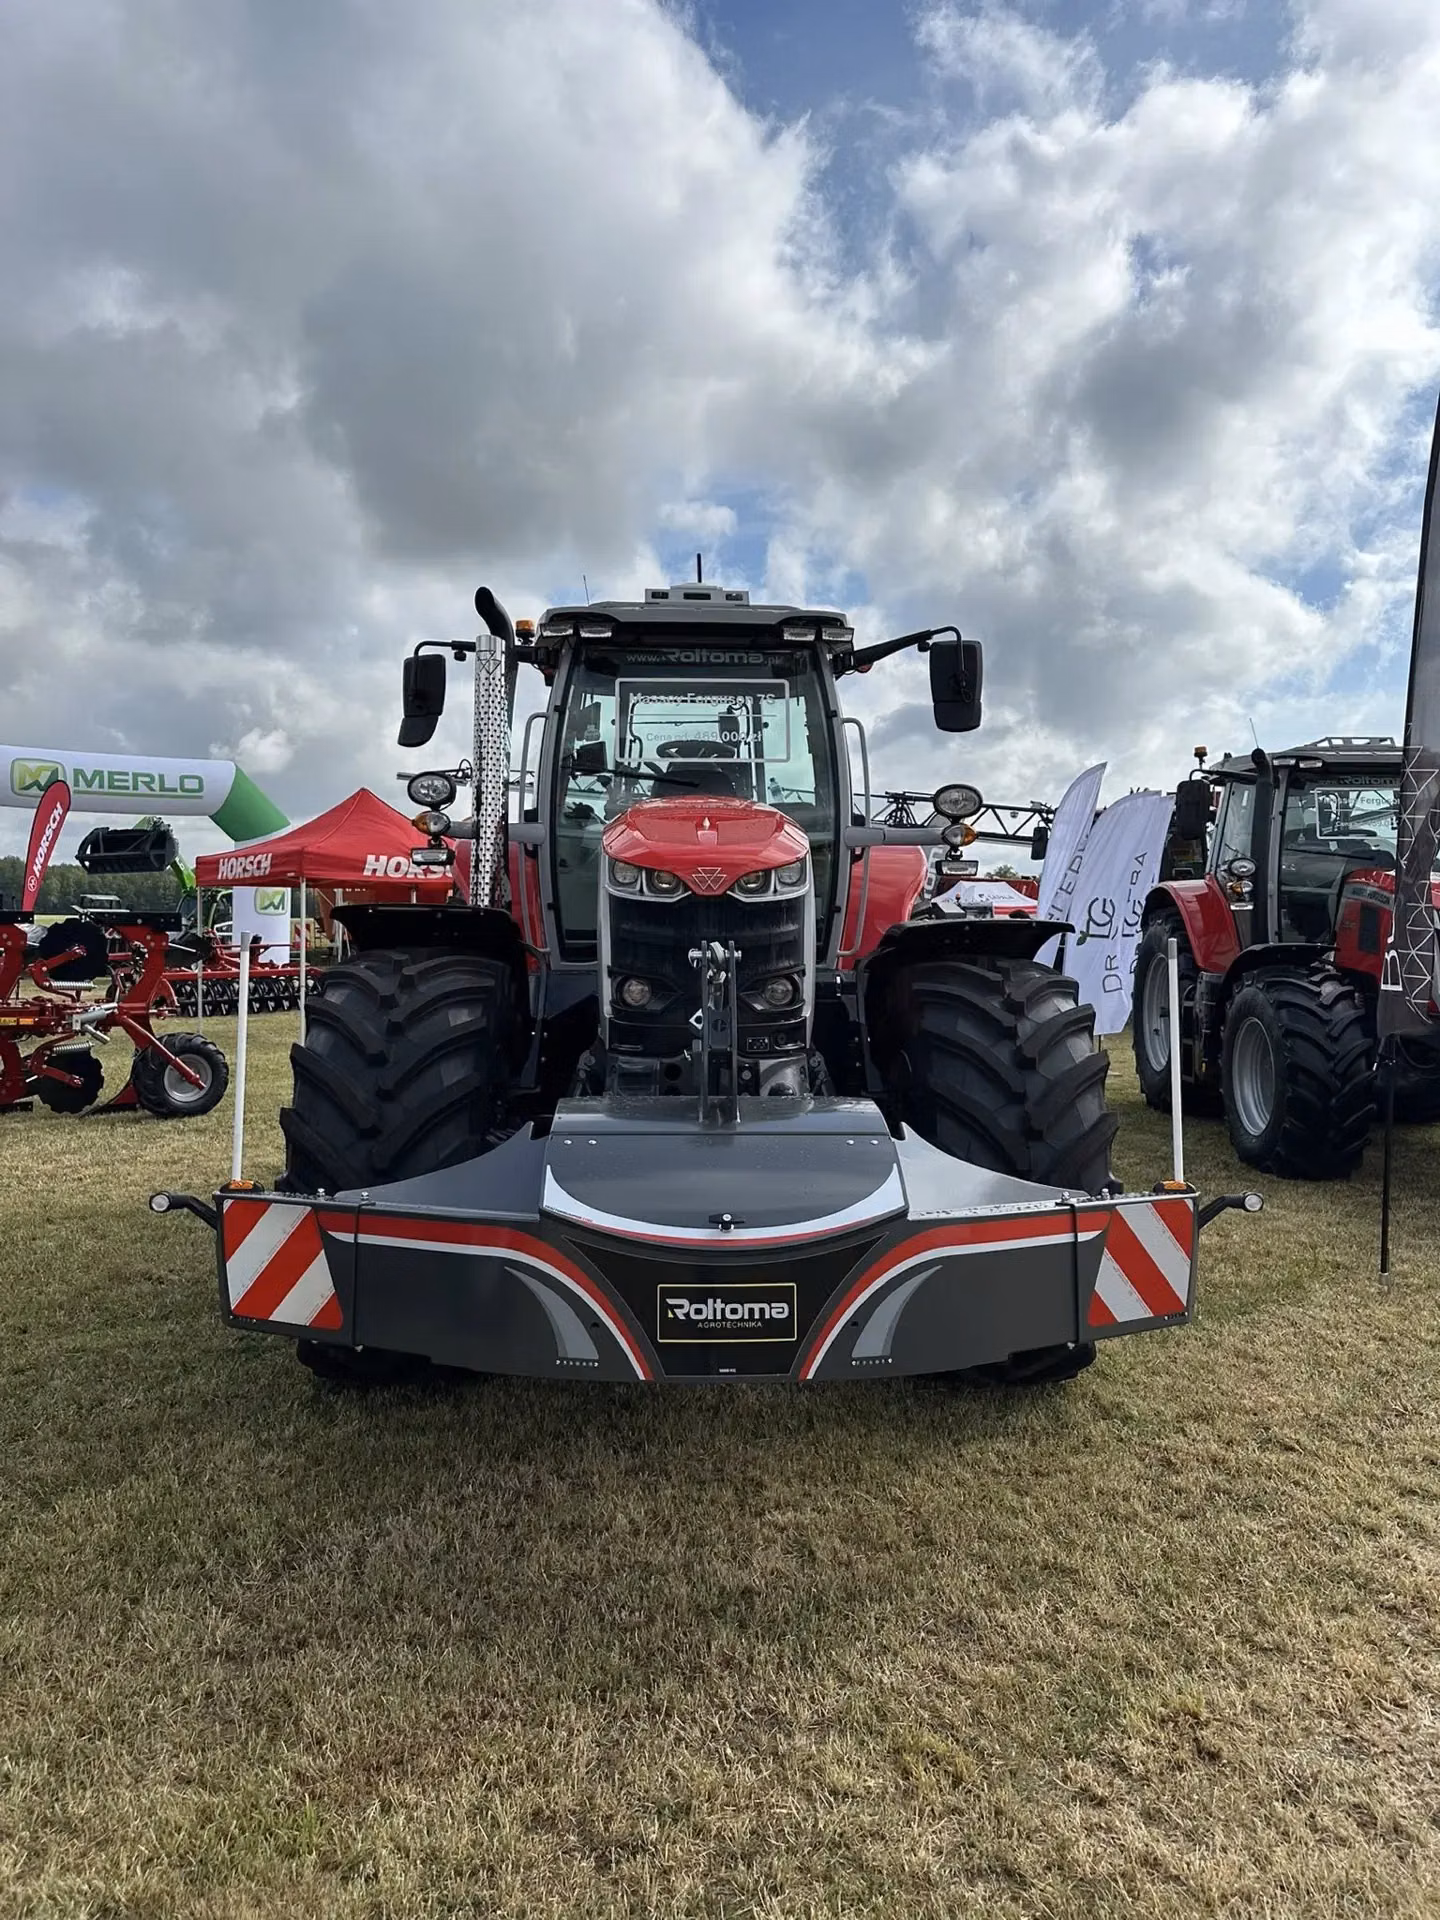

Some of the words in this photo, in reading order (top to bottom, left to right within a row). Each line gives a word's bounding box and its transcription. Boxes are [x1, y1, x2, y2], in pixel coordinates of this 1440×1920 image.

[629, 693, 684, 706] Massey
[687, 693, 753, 706] Ferguson
[757, 694, 776, 704] 7S
[646, 732, 672, 741] Cena
[73, 768, 205, 793] MERLO
[32, 801, 64, 878] HORSCH
[217, 853, 273, 880] HORSCH
[665, 1298, 789, 1320] Roltoma
[697, 1321, 762, 1329] AGROTECHNIKA
